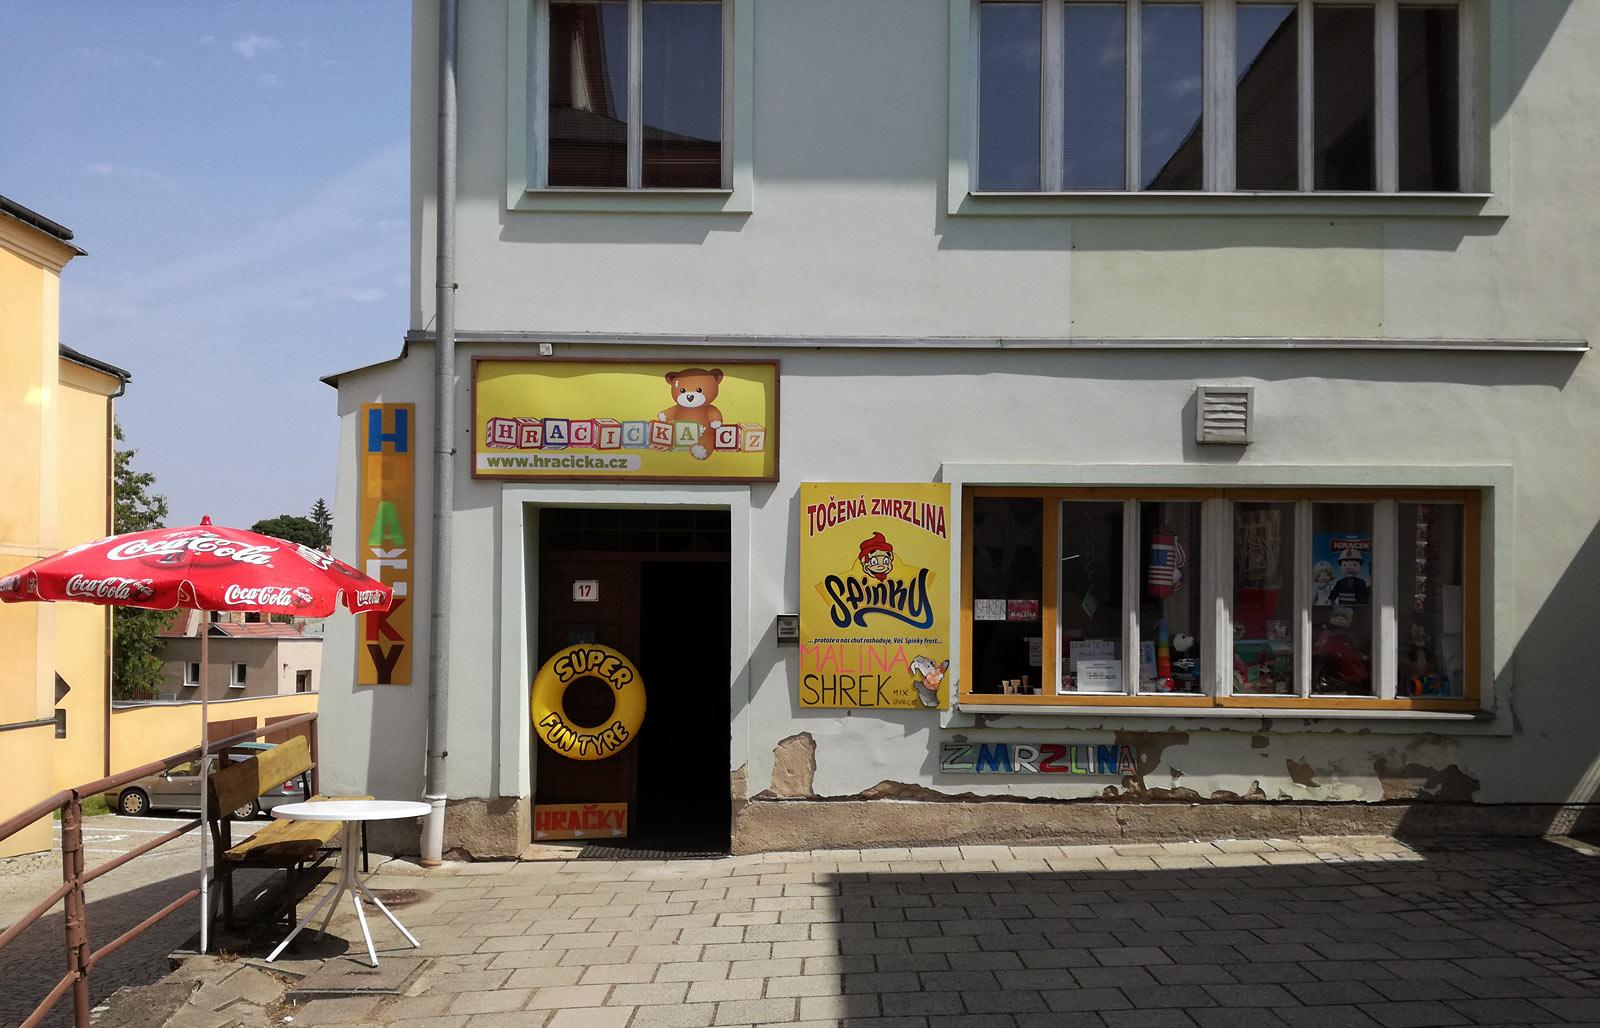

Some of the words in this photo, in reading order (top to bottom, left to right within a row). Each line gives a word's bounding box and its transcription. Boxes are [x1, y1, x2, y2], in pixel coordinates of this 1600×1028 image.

[486, 455, 629, 469] www.hracicka.cz
[807, 494, 867, 537] TOČENÁ
[871, 498, 947, 539] ZMRZLINA
[578, 585, 592, 597] 17
[554, 649, 633, 690] SUPER
[800, 645, 909, 673] MALINA
[802, 674, 892, 707] SHREK
[540, 712, 577, 752] FUN
[577, 721, 629, 756] TYRE
[942, 743, 1137, 774] ZMRZLINA
[535, 805, 627, 832] HRAČKY
